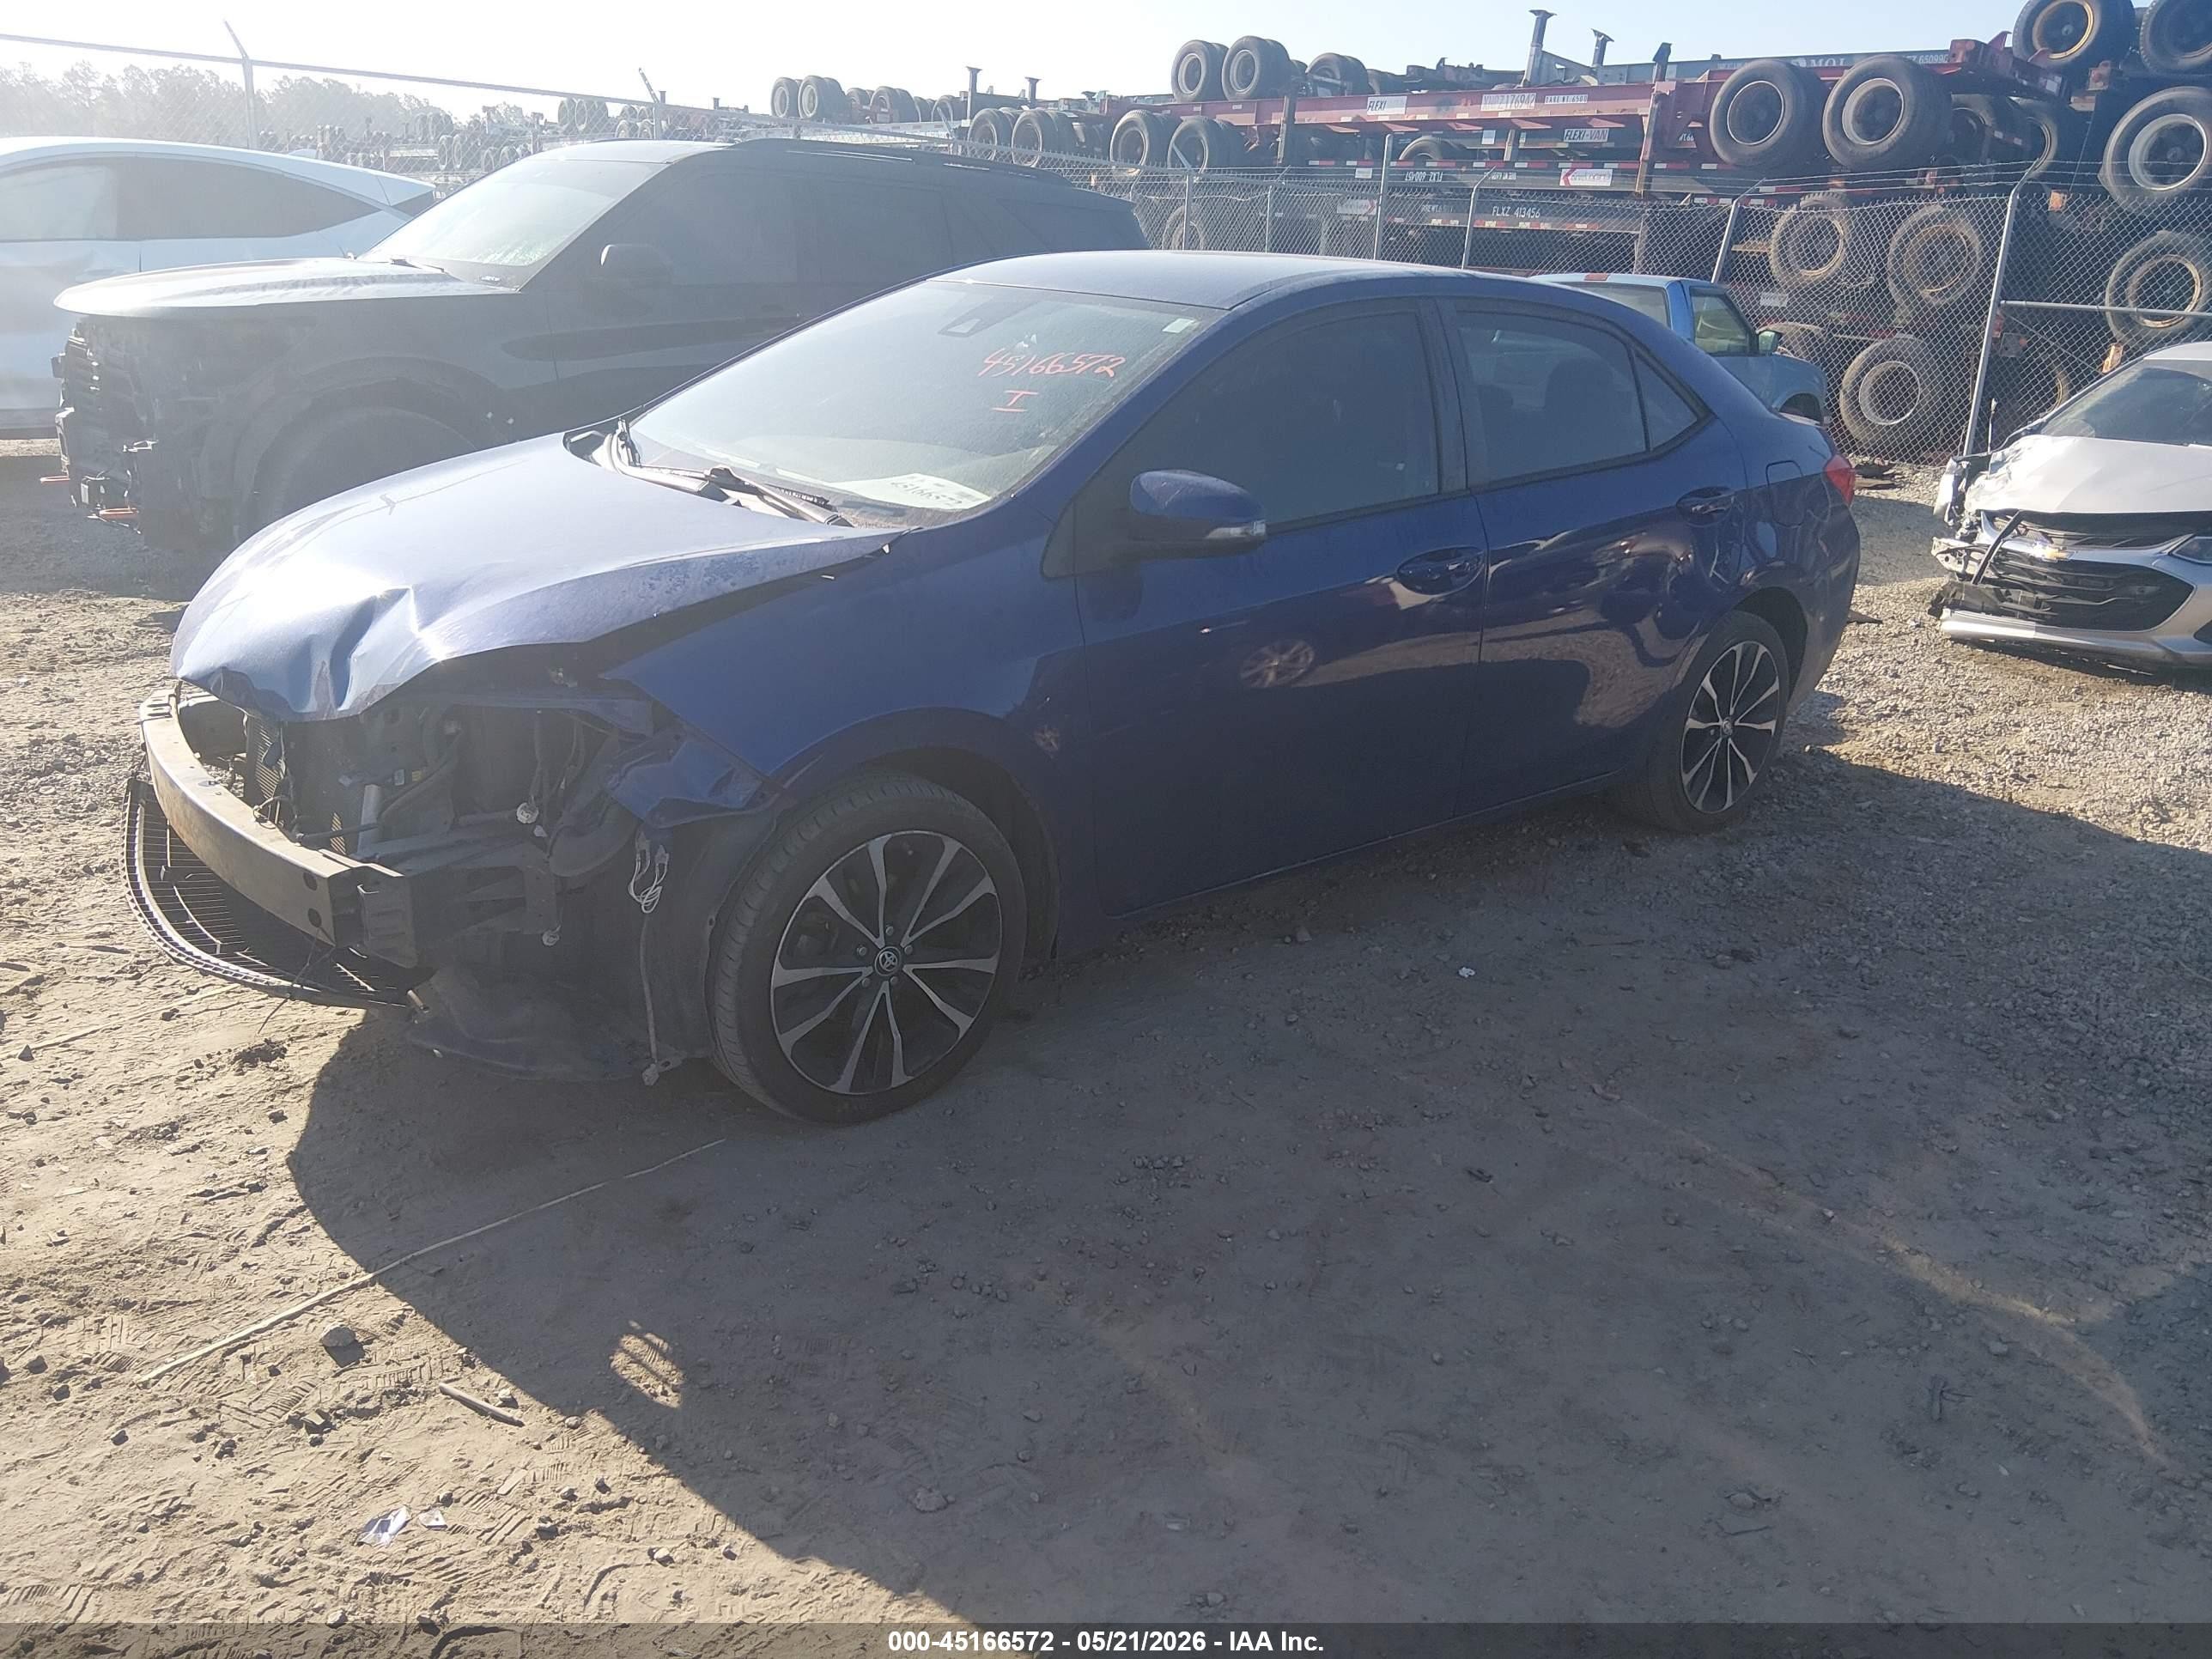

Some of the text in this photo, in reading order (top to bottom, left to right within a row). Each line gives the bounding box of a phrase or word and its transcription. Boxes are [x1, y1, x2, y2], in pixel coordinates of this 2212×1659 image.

[1565, 130, 1607, 141] FLEXI-VAN
[1492, 206, 1540, 218] FLXZ 413456
[978, 348, 1126, 378] 45166572
